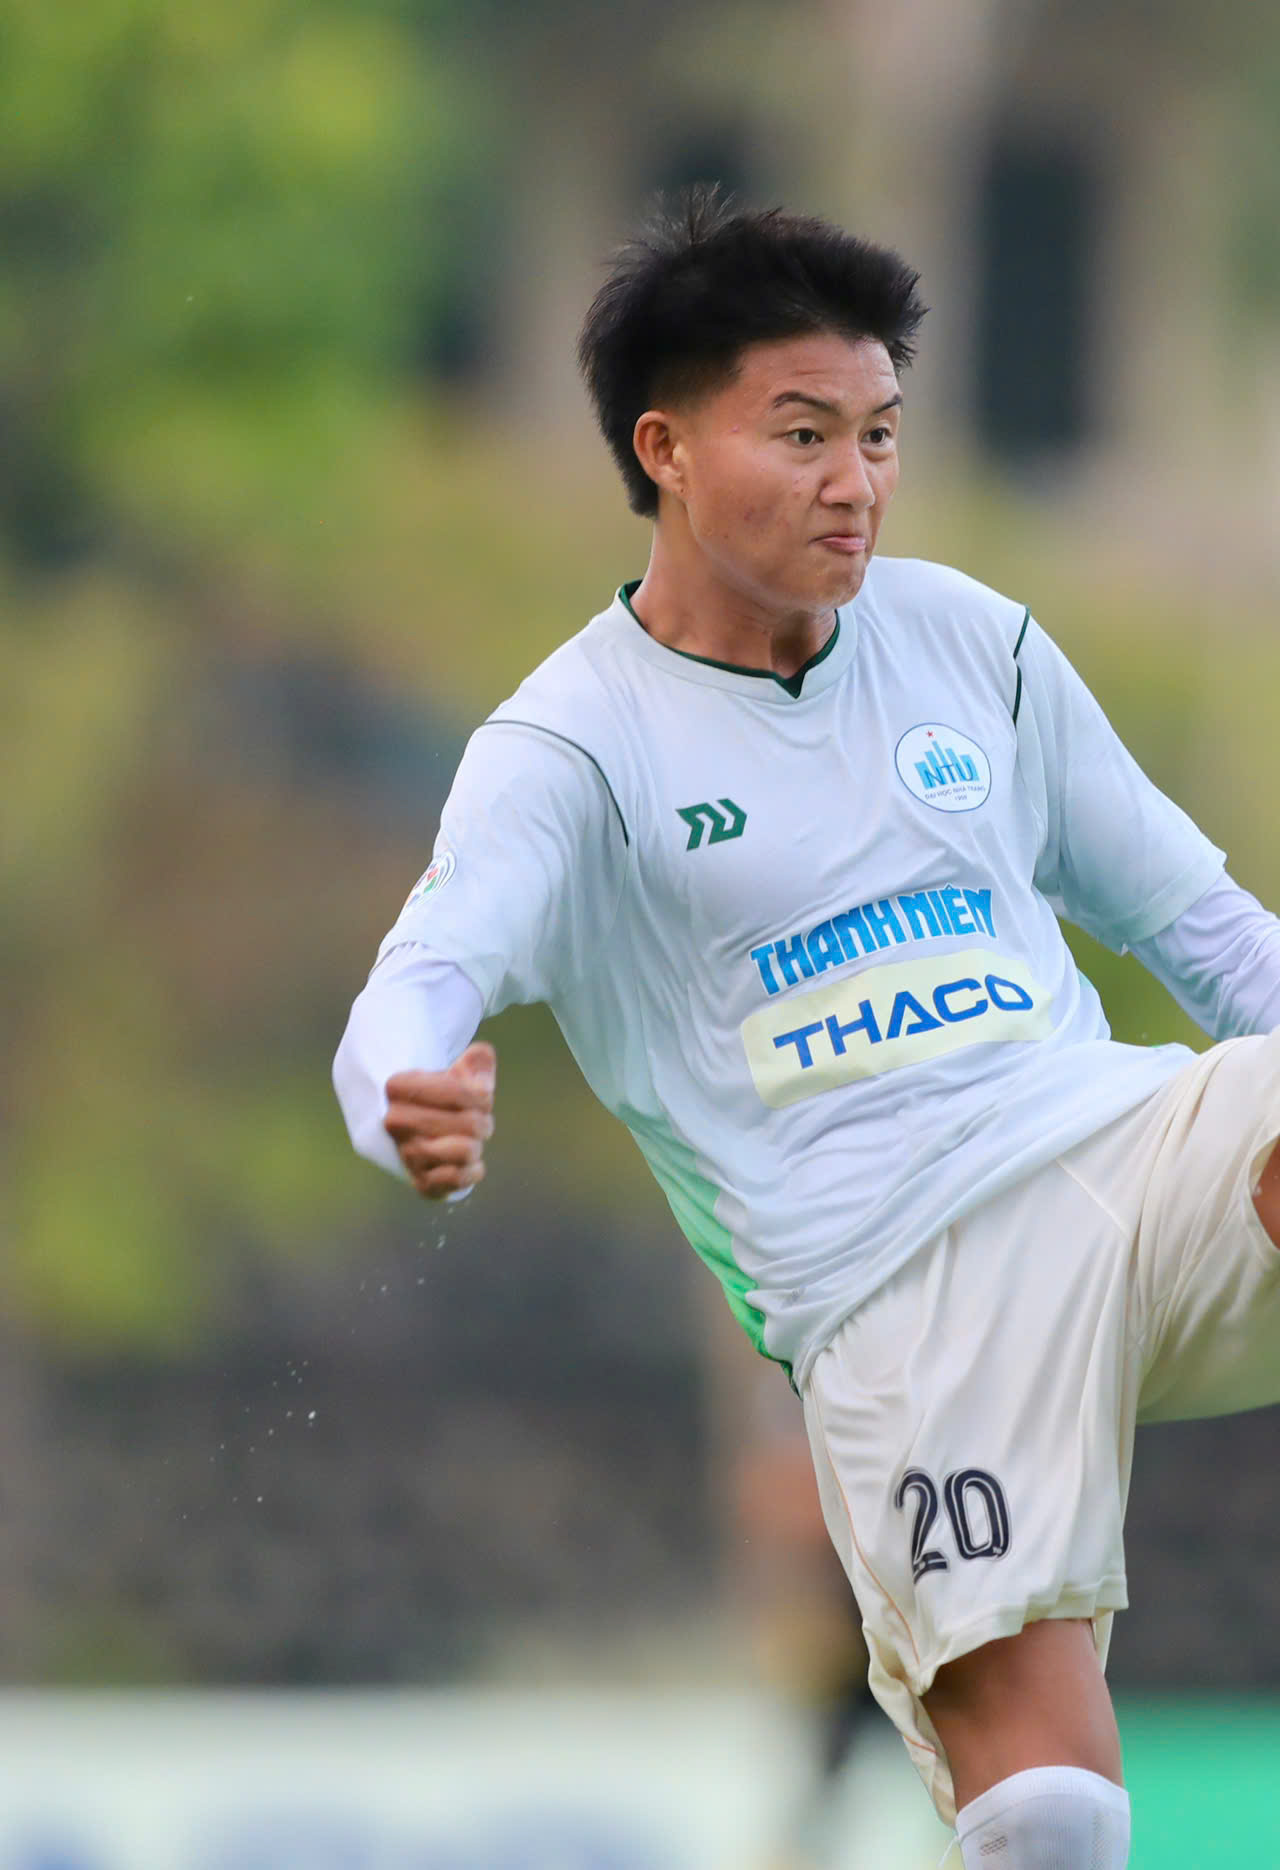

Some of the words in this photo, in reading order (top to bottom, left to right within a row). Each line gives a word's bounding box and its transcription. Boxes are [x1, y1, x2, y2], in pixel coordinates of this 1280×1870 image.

[749, 898, 901, 996] THANH
[896, 882, 997, 941] NIÊN
[772, 973, 1034, 1069] THACO
[894, 1466, 1012, 1585] 20
